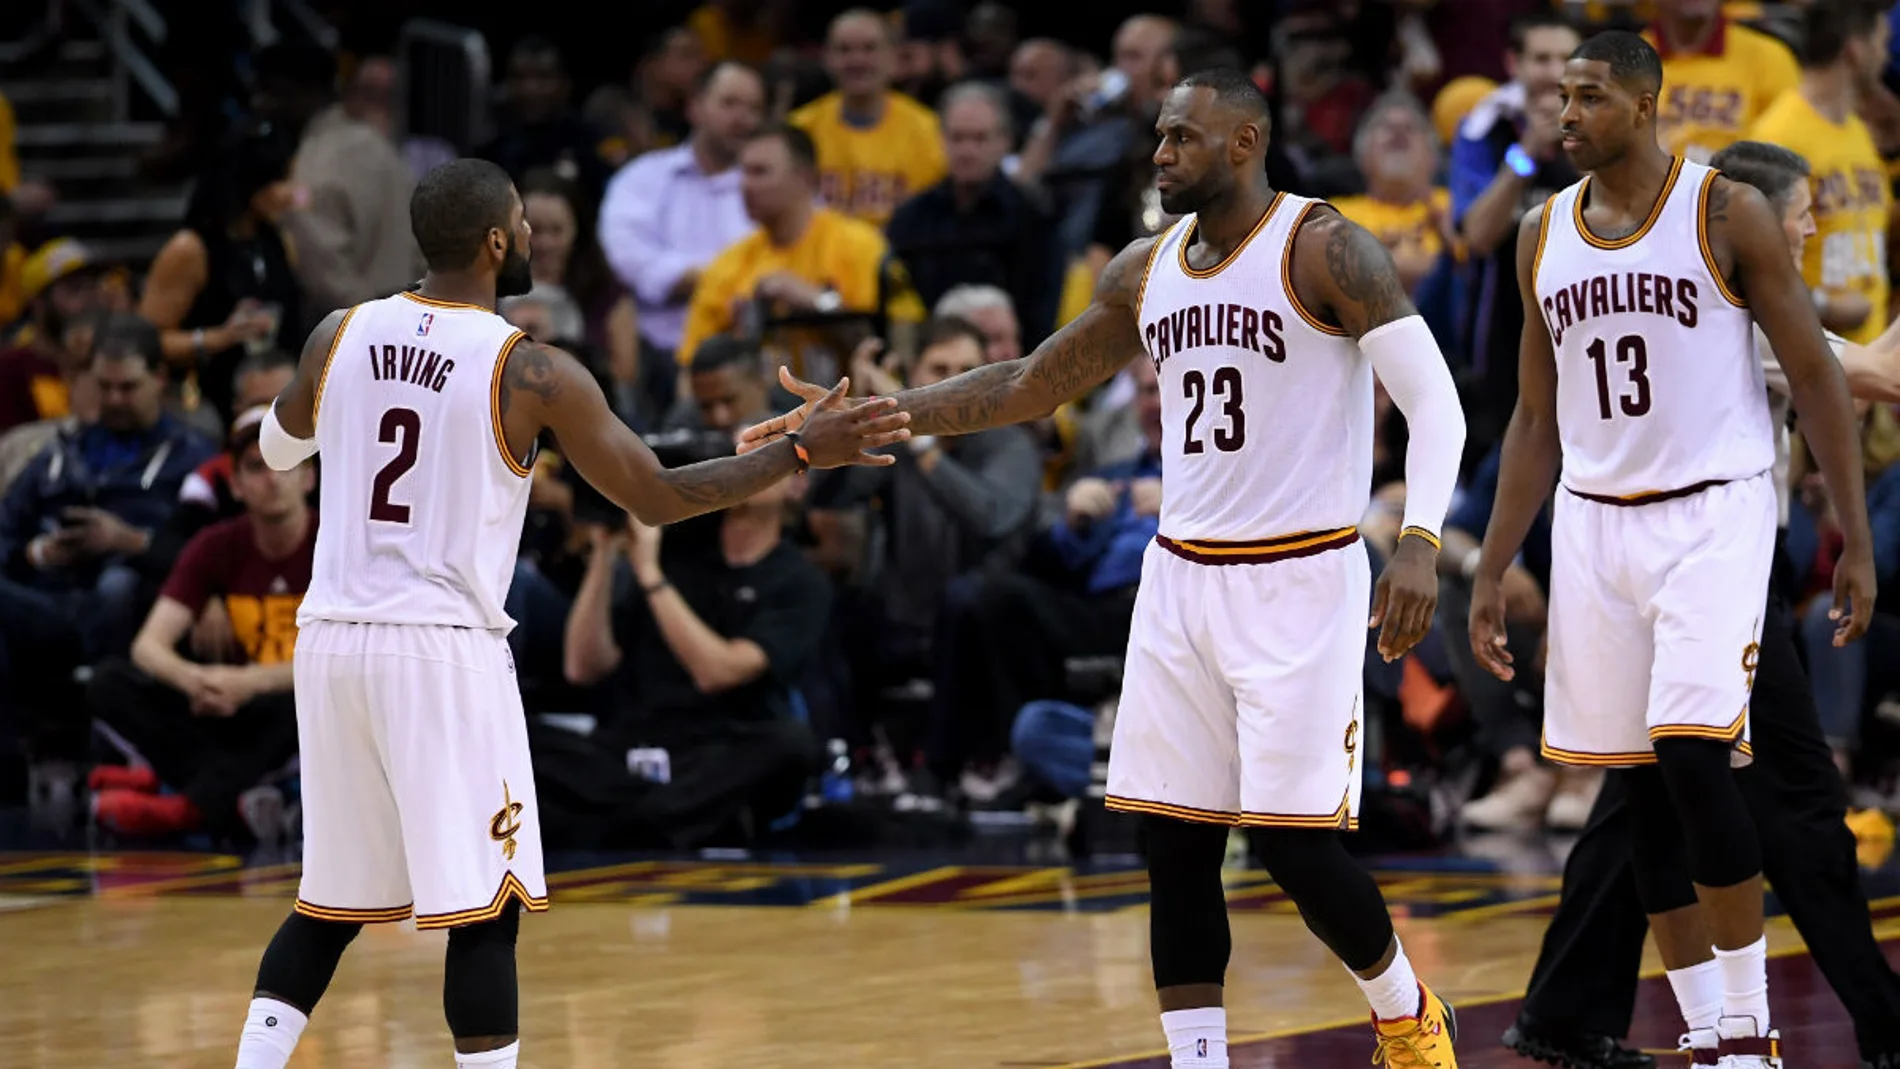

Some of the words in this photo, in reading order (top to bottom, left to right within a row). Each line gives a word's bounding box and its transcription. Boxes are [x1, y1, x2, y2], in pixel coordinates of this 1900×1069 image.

[1146, 303, 1287, 376] CAVALIERS
[1543, 272, 1698, 347] CAVALIERS
[368, 344, 455, 393] IRVING
[1585, 334, 1652, 420] 13
[1183, 366, 1246, 455] 23
[368, 406, 421, 524] 2
